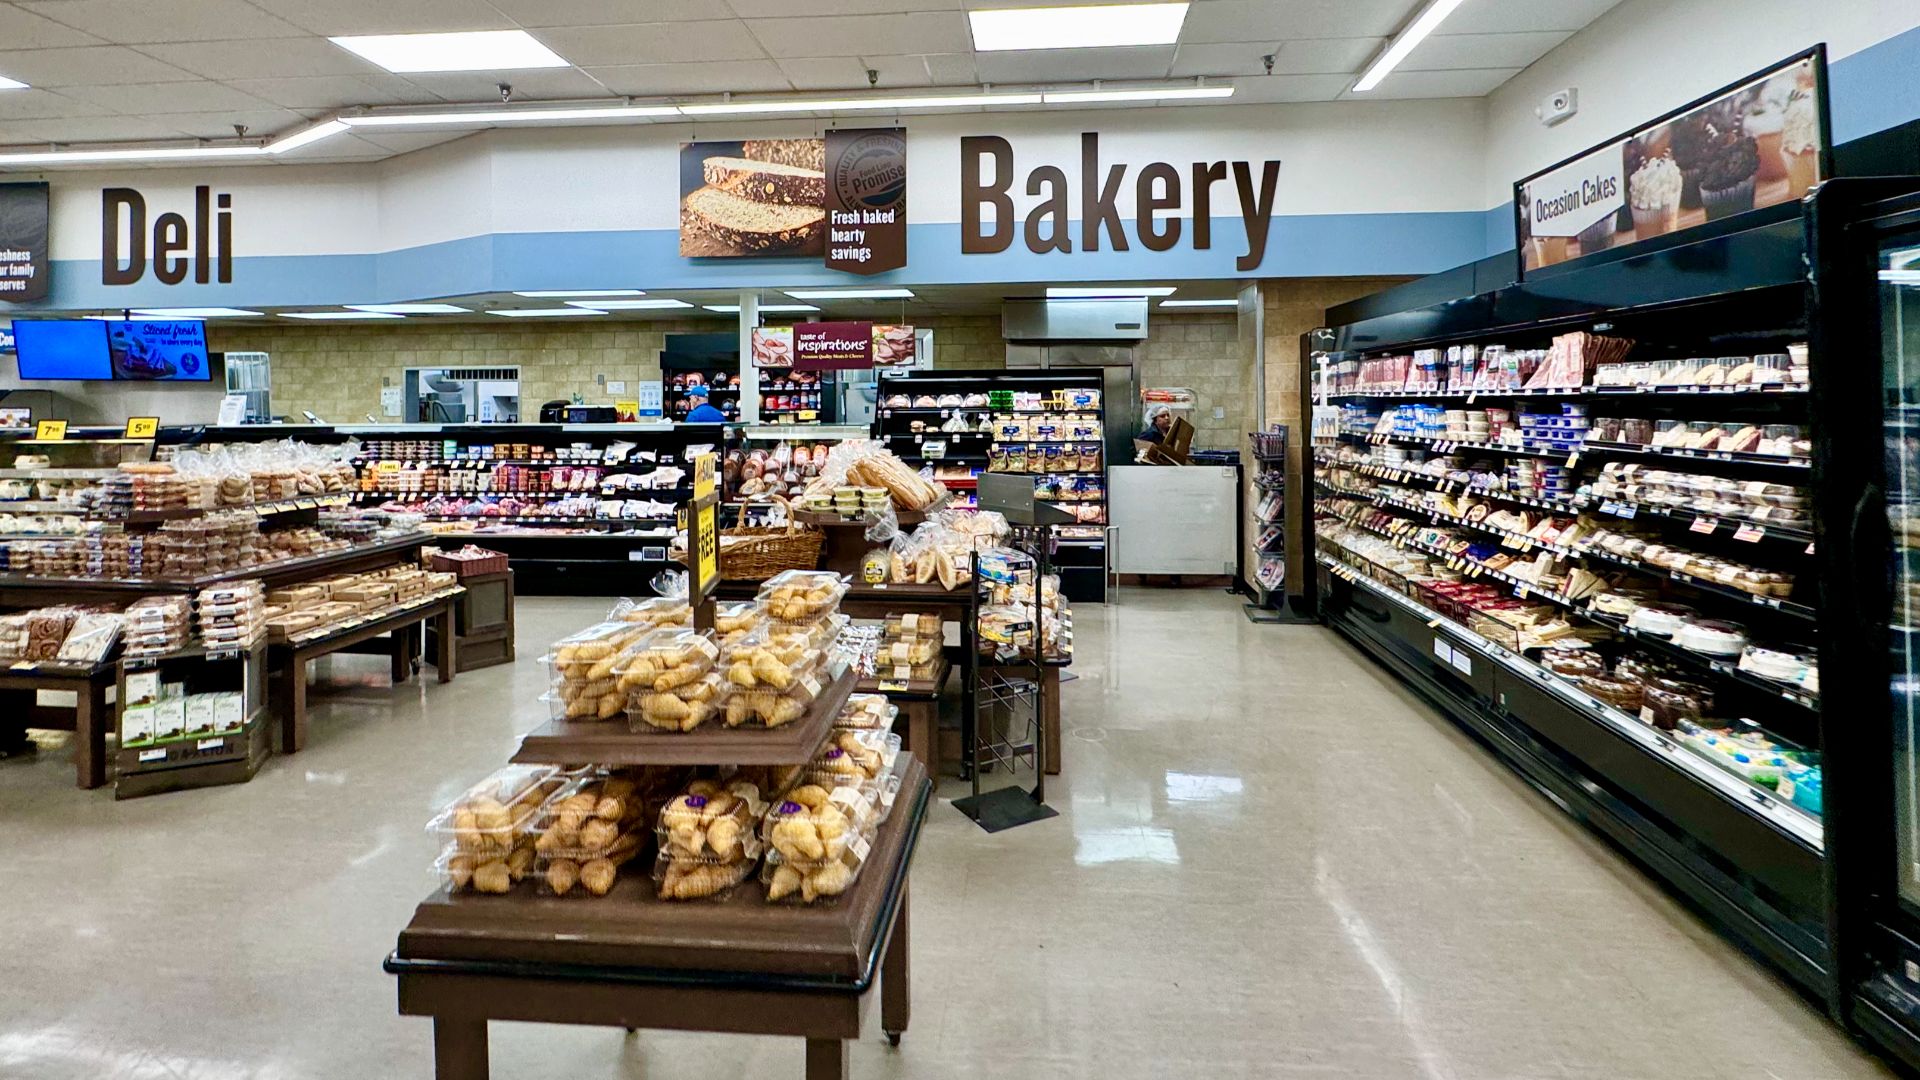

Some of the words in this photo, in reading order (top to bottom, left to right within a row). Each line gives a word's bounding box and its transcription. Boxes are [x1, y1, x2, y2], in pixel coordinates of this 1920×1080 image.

[852, 165, 905, 194] Promise
[961, 132, 1281, 271] Bakery
[1536, 189, 1580, 223] Occasion
[1583, 175, 1617, 206] Cakes
[831, 209, 860, 225] Fresh
[863, 208, 895, 224] baked
[102, 185, 232, 285] Deli
[831, 227, 865, 245] hearty
[831, 245, 872, 263] savings
[9, 263, 35, 279] family
[143, 323, 172, 336] Sliced
[817, 331, 827, 341] of
